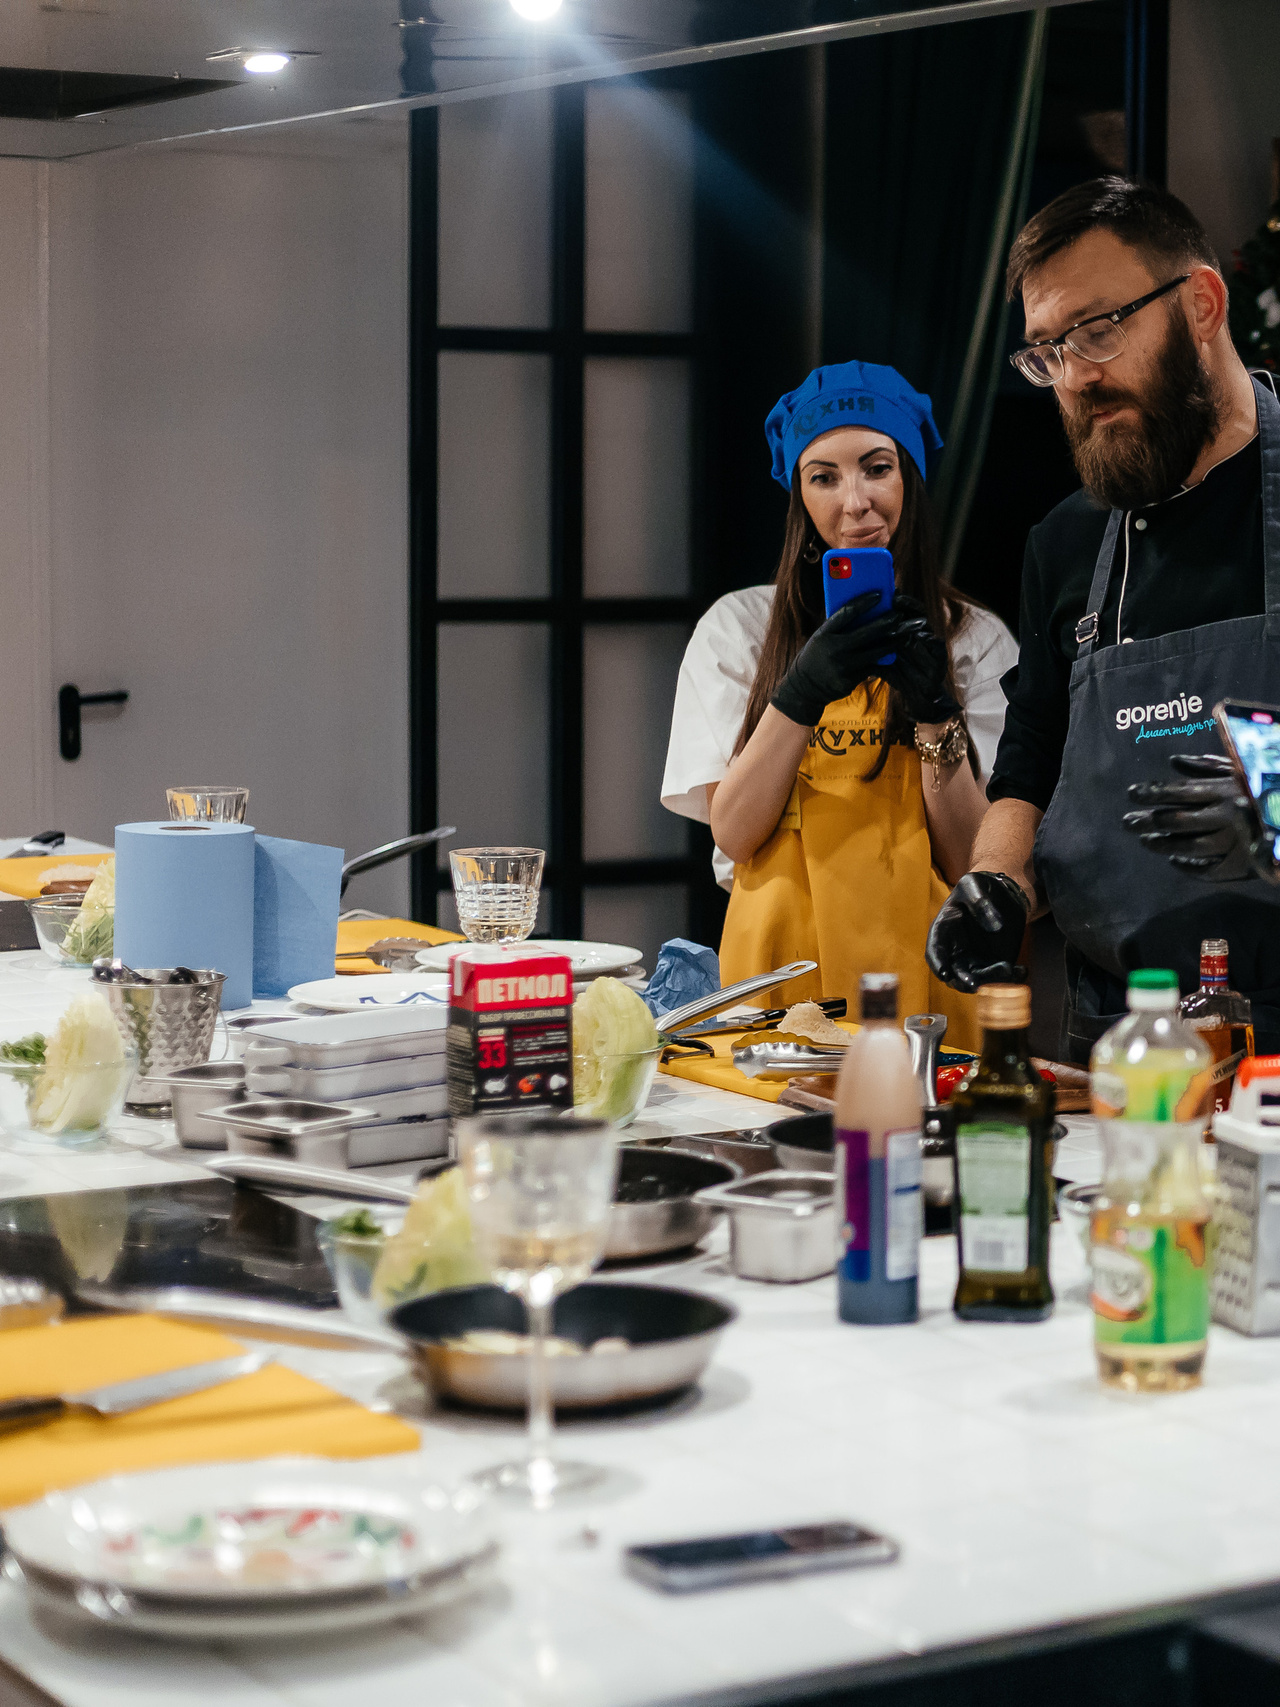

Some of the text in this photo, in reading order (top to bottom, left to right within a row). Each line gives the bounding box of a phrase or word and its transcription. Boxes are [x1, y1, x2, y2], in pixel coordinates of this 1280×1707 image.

[793, 397, 874, 440] КУХНЯ
[1116, 692, 1203, 730] gorenje
[809, 727, 907, 756] КУХН
[478, 973, 567, 1004] ПЕТМОЛ
[478, 1042, 507, 1069] 33
